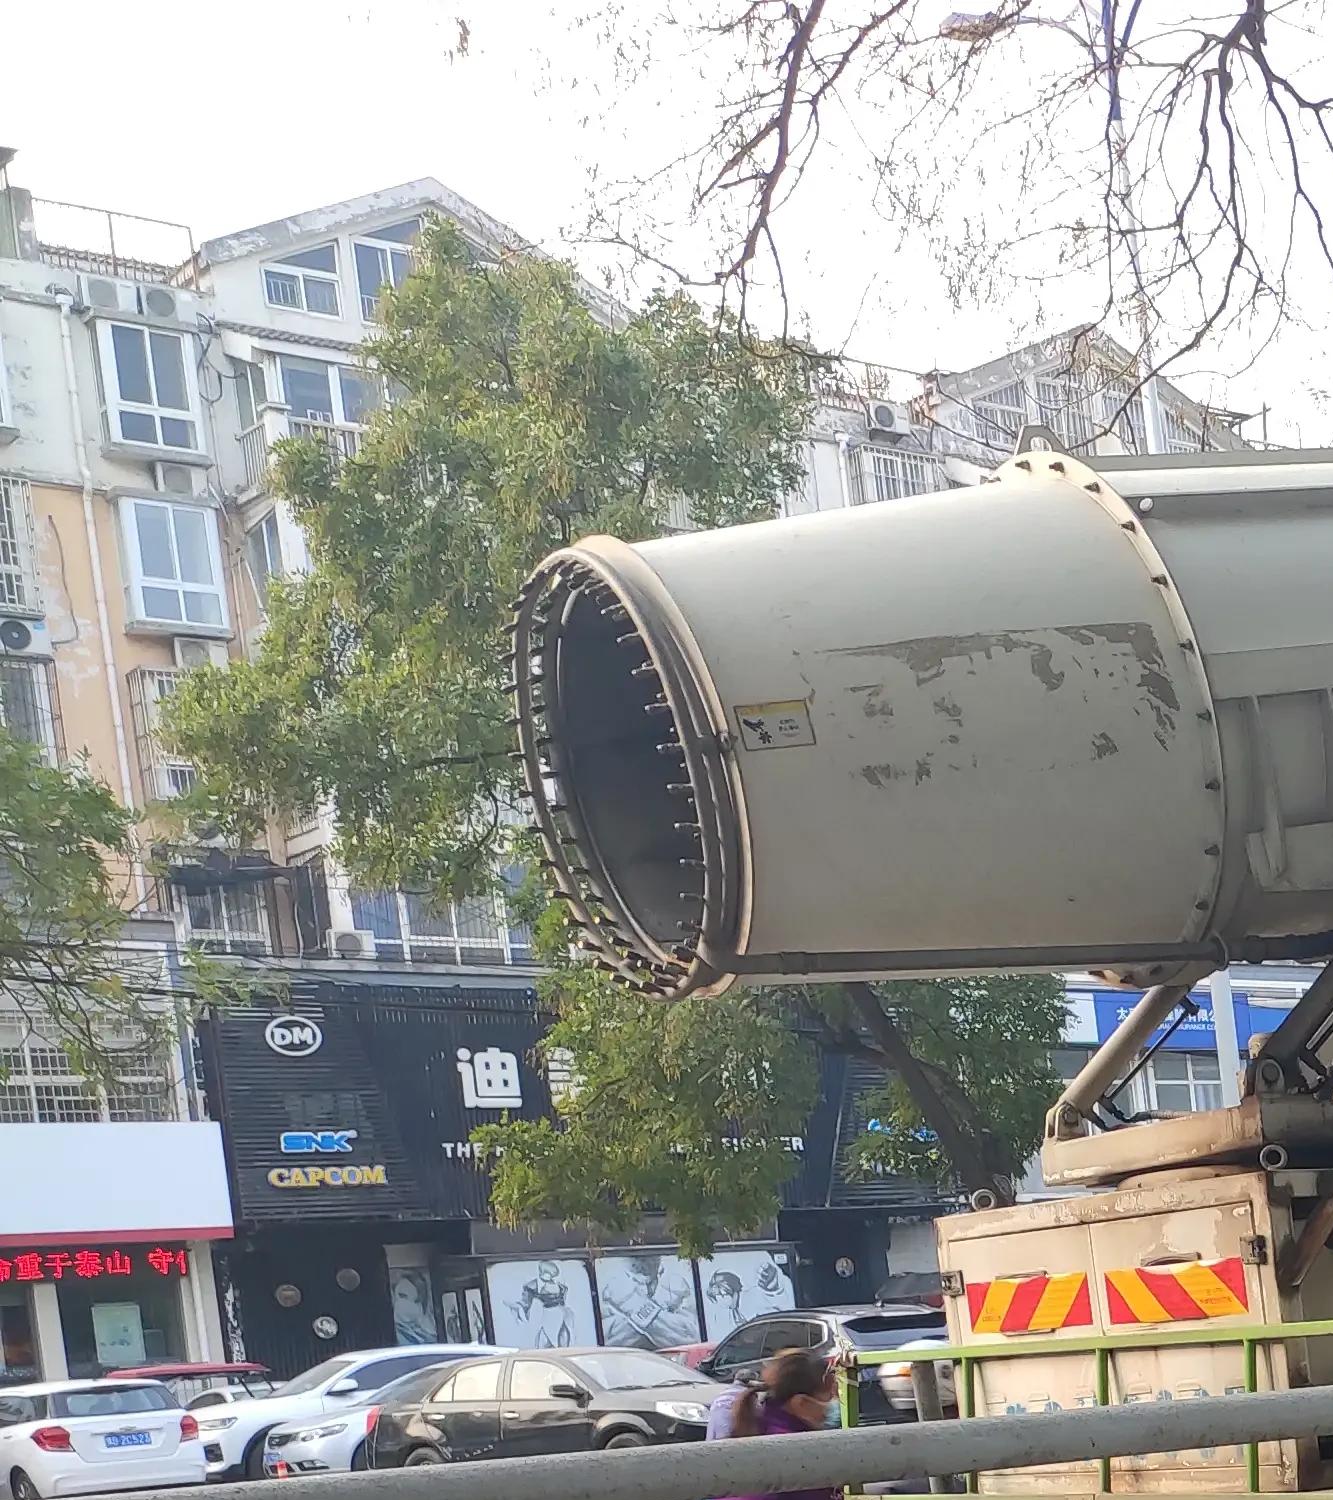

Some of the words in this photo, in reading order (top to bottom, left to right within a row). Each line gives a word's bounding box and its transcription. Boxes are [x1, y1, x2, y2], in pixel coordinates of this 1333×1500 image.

[272, 1026, 314, 1046] DM
[280, 1130, 358, 1153] SNK
[268, 1164, 387, 1190] CAPCOM
